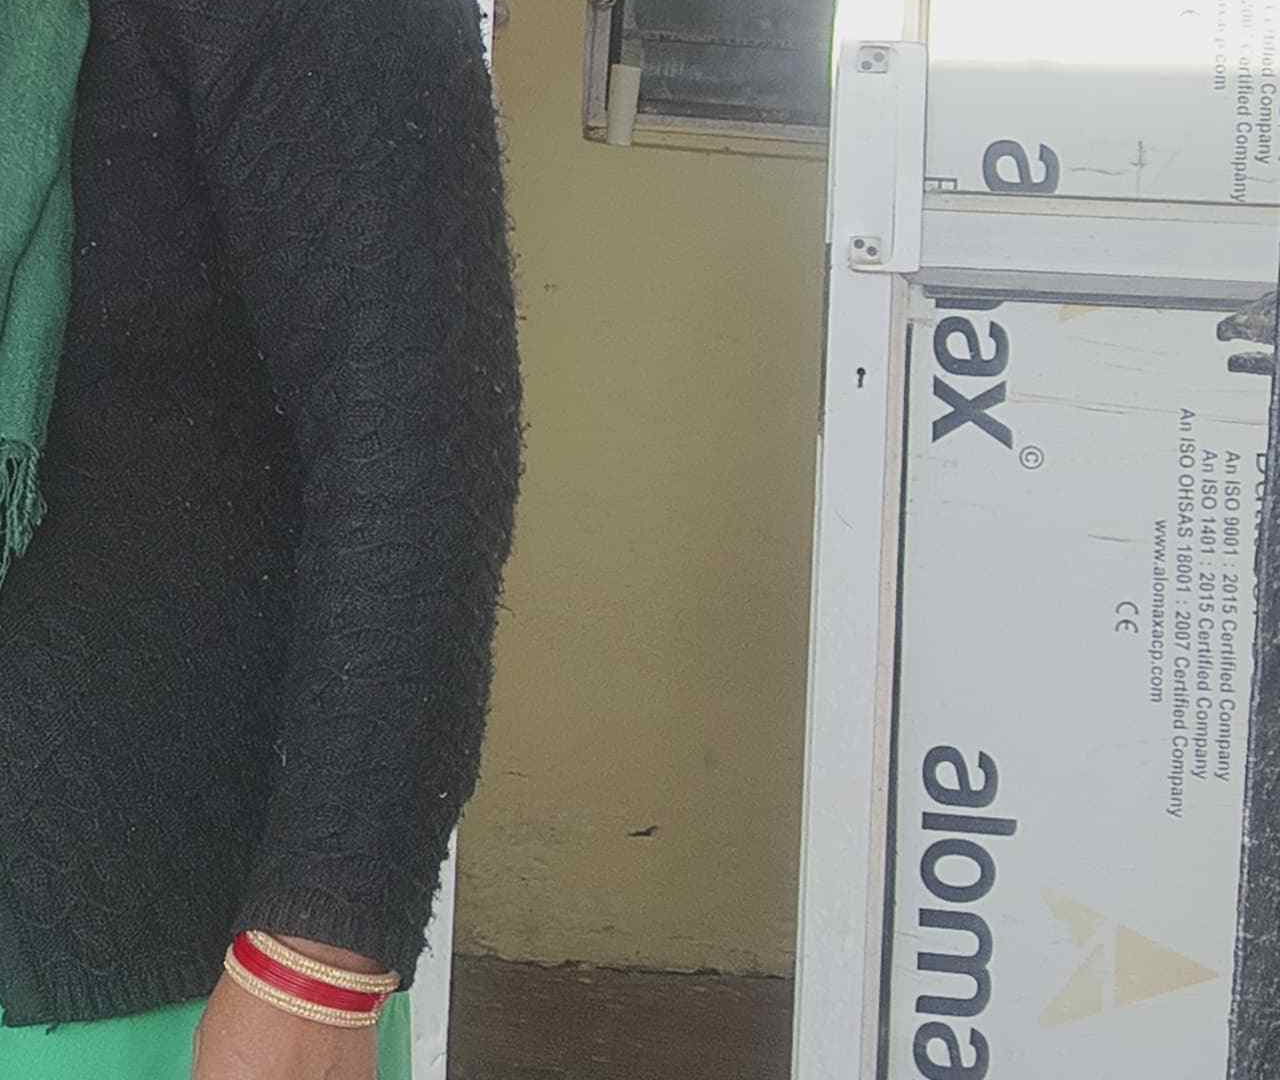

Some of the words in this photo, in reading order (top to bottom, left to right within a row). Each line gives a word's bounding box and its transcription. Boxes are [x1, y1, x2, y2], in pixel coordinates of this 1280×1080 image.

[1254, 83, 1278, 165] Company
[1230, 121, 1253, 203] Company
[932, 297, 1013, 450] ax
[1179, 408, 1196, 432] An
[1179, 437, 1196, 469] ISO
[1201, 449, 1218, 473] An
[1224, 450, 1241, 475] An
[1177, 474, 1195, 539] OHSAS
[1201, 479, 1217, 510] ISO
[1224, 480, 1241, 511] ISO
[1199, 516, 1216, 555] 1401
[1223, 517, 1239, 556] 9001
[1175, 546, 1193, 594] 18001
[1198, 572, 1215, 613] 2015
[1222, 573, 1238, 614] 2015
[1148, 520, 1169, 703] www.alomaxacp.com
[1174, 611, 1191, 651] 2007
[1196, 617, 1214, 692] Certified
[1219, 619, 1238, 693] Certified
[1172, 656, 1190, 730] Certified
[1191, 697, 1213, 781] Company
[1214, 699, 1236, 782] Company
[1166, 735, 1189, 818] Company
